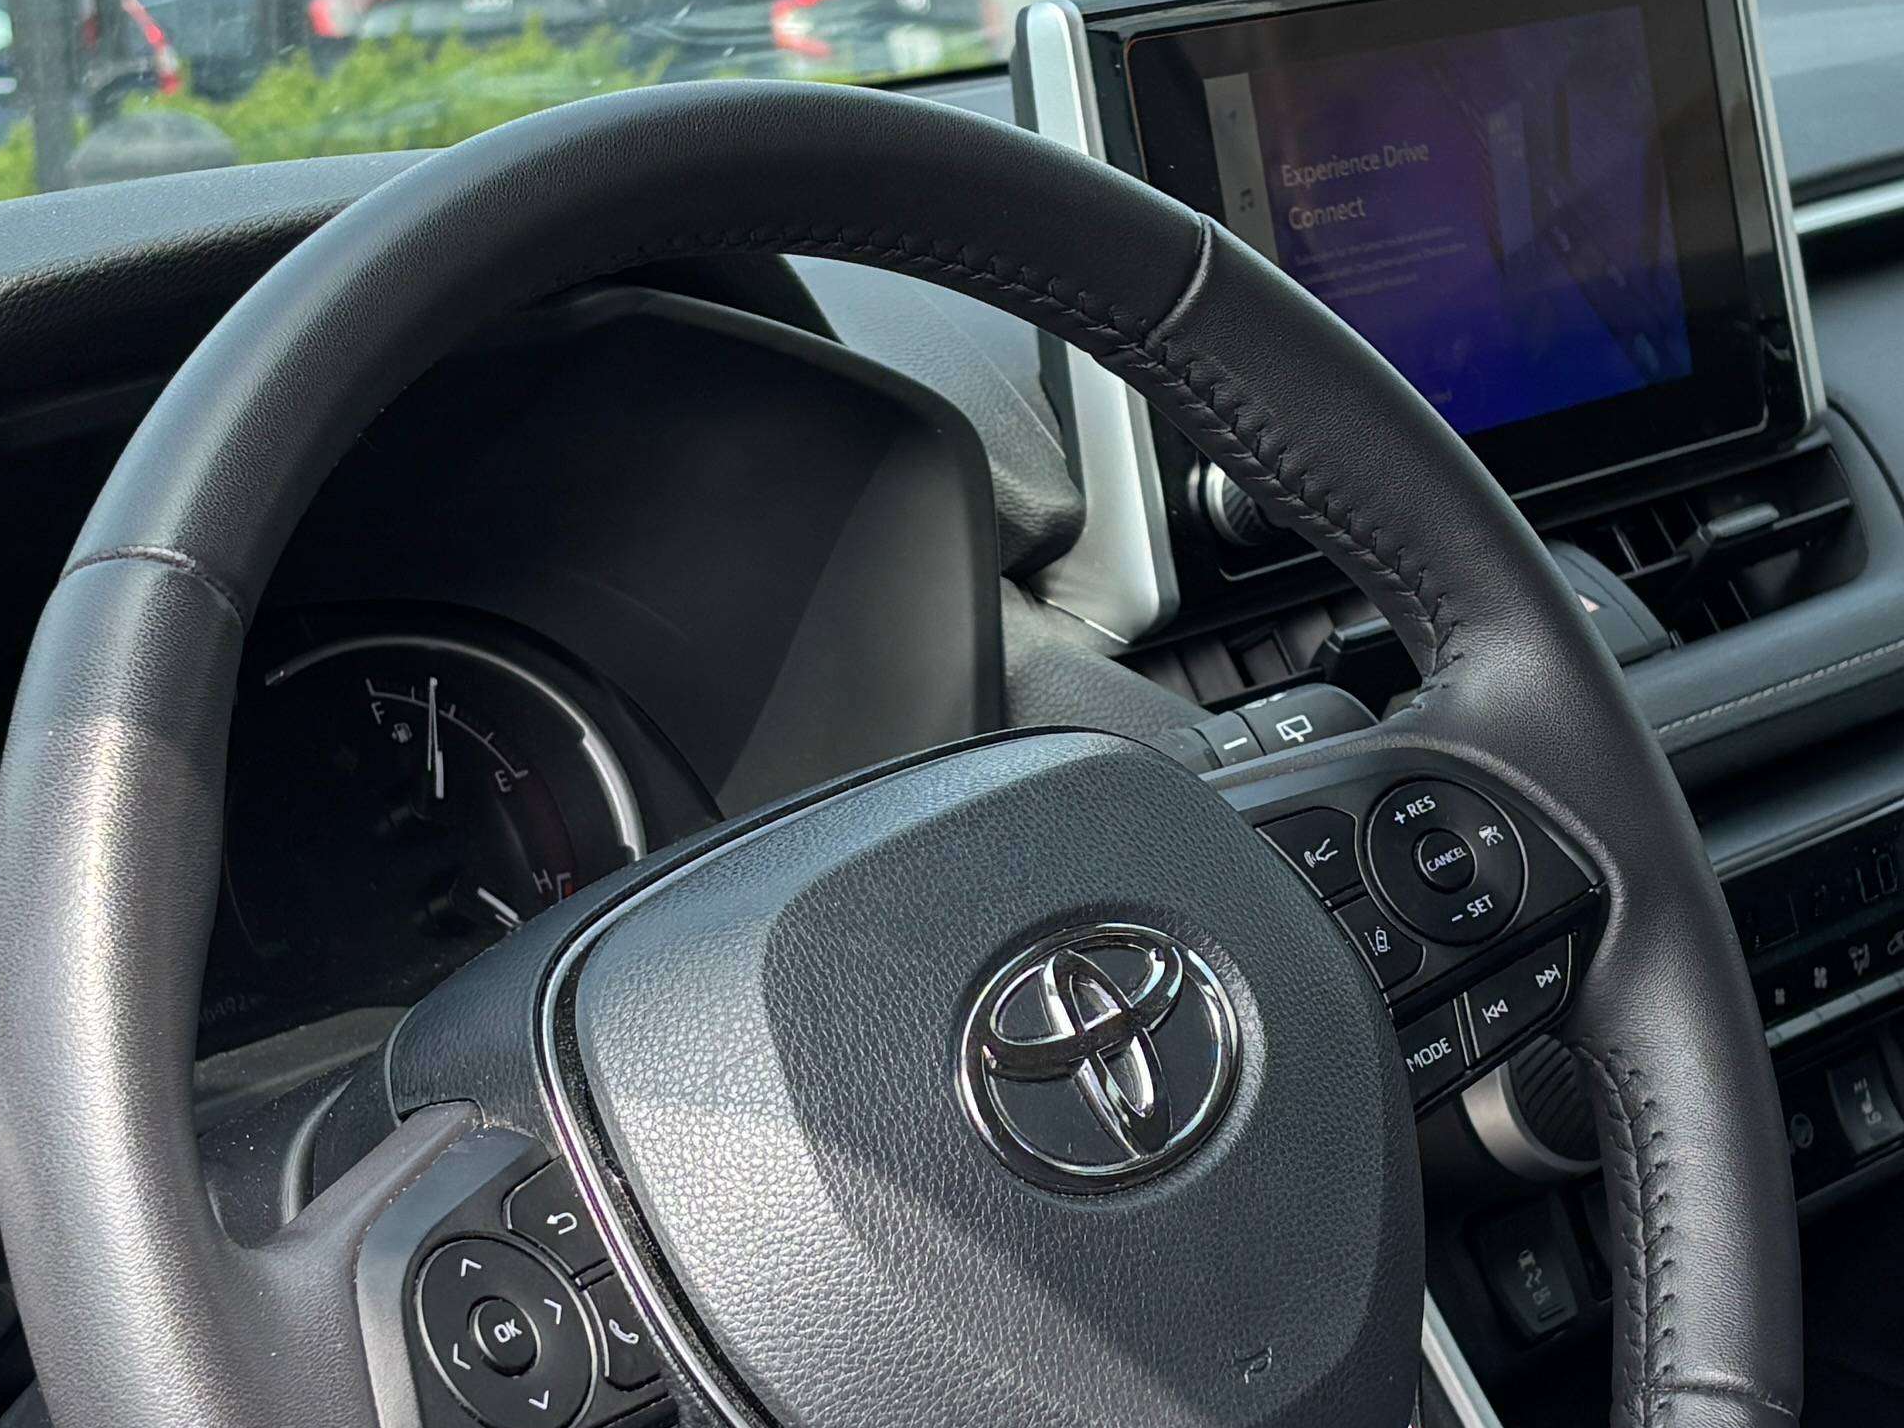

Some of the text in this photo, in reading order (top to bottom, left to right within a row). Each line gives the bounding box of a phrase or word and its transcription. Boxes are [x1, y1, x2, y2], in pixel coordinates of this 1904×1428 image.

[1281, 142, 1430, 188] Experience Drive
[1288, 197, 1366, 230] Connect
[369, 700, 387, 726] F
[493, 769, 513, 794] E
[1426, 845, 1467, 872] CANCEL
[531, 868, 555, 894] H
[1405, 1036, 1453, 1073] MODE
[493, 1318, 521, 1345] OK
